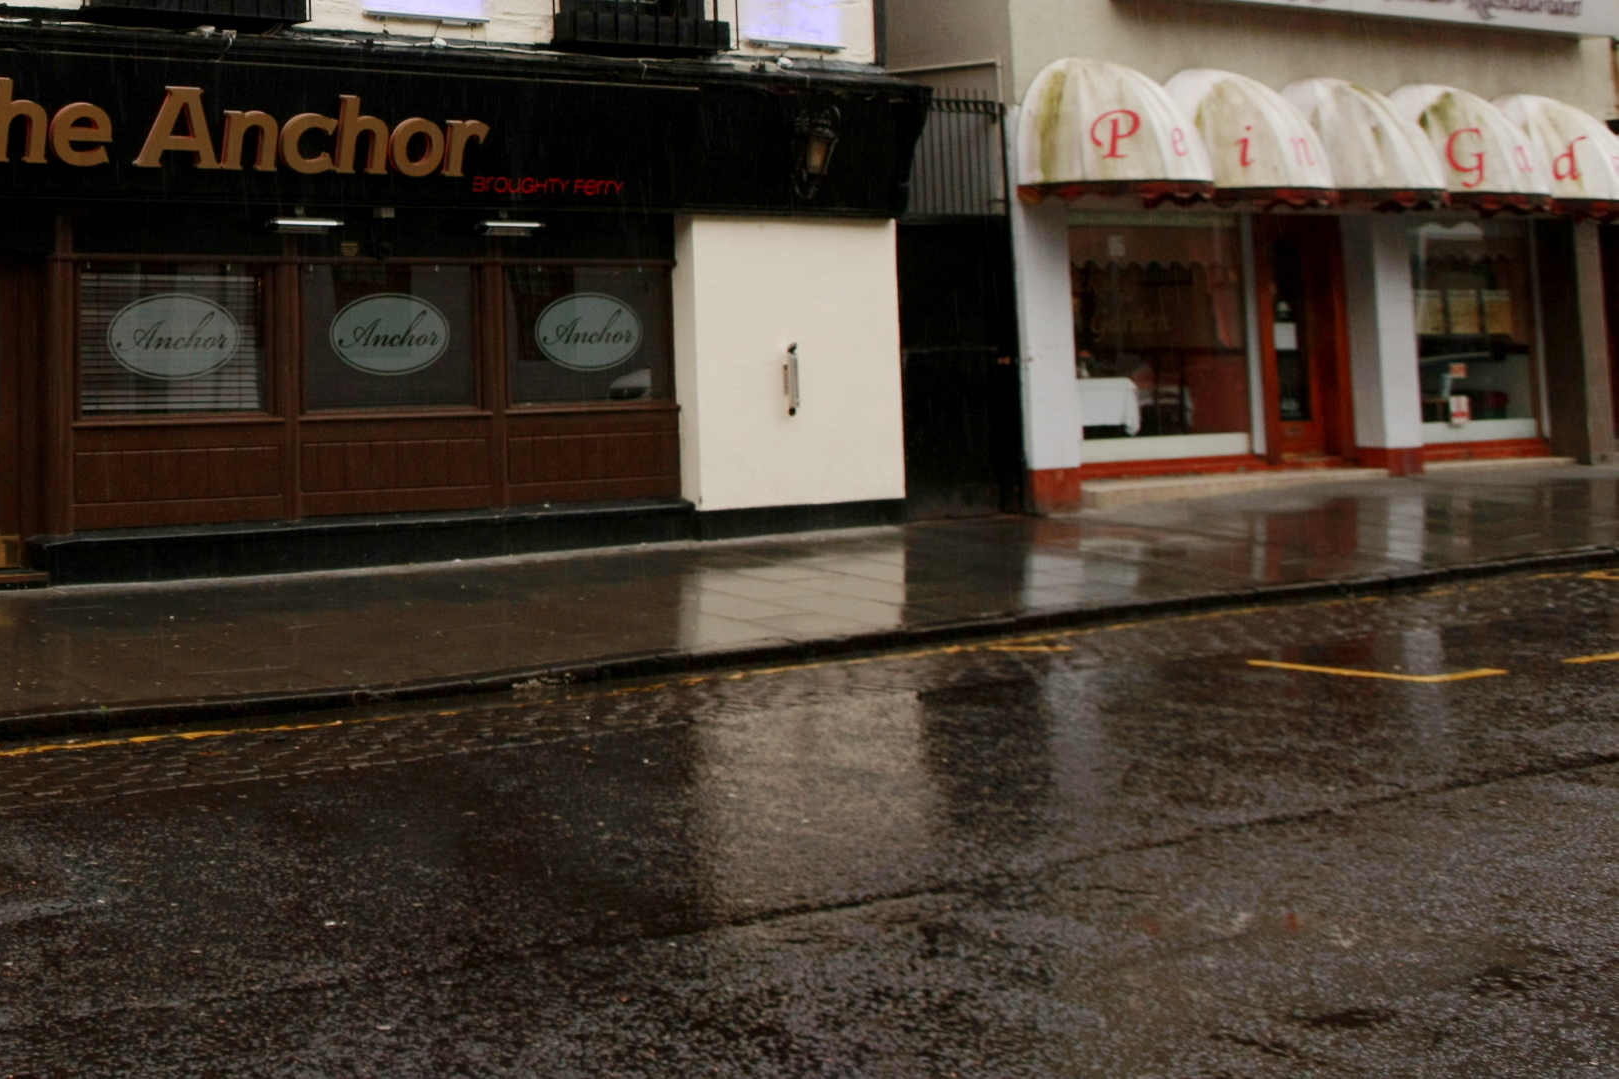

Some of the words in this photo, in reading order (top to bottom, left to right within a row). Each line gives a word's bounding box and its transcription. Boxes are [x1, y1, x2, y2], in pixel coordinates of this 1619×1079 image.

[132, 85, 490, 177] Anchor
[116, 311, 229, 352] Anchor
[338, 309, 440, 349] Anchor
[542, 308, 633, 345] Anchor
